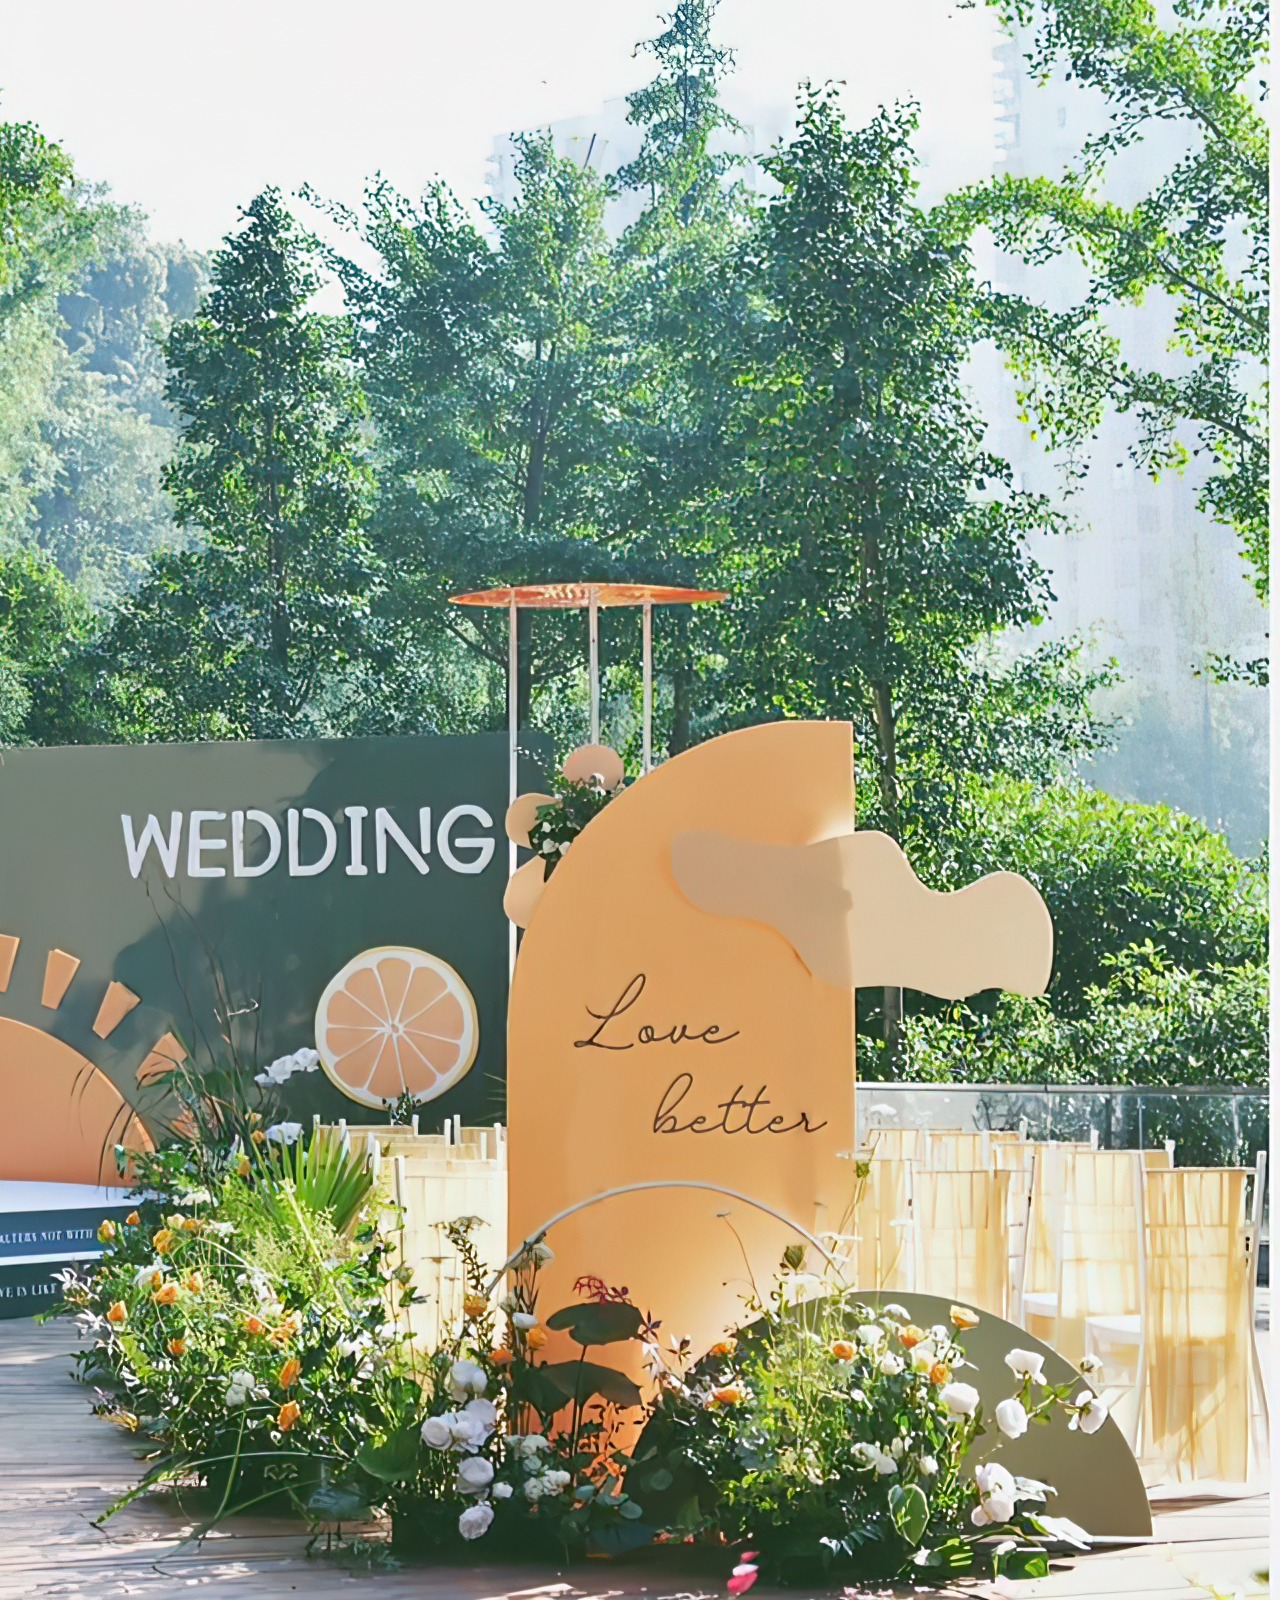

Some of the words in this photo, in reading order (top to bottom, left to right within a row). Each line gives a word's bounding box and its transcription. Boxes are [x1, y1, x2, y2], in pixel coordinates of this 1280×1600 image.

[121, 804, 496, 879] WEDDING
[573, 972, 741, 1051] Love
[652, 1072, 828, 1135] better
[41, 1230, 62, 1242] NOT
[31, 1283, 58, 1296] LIKE
